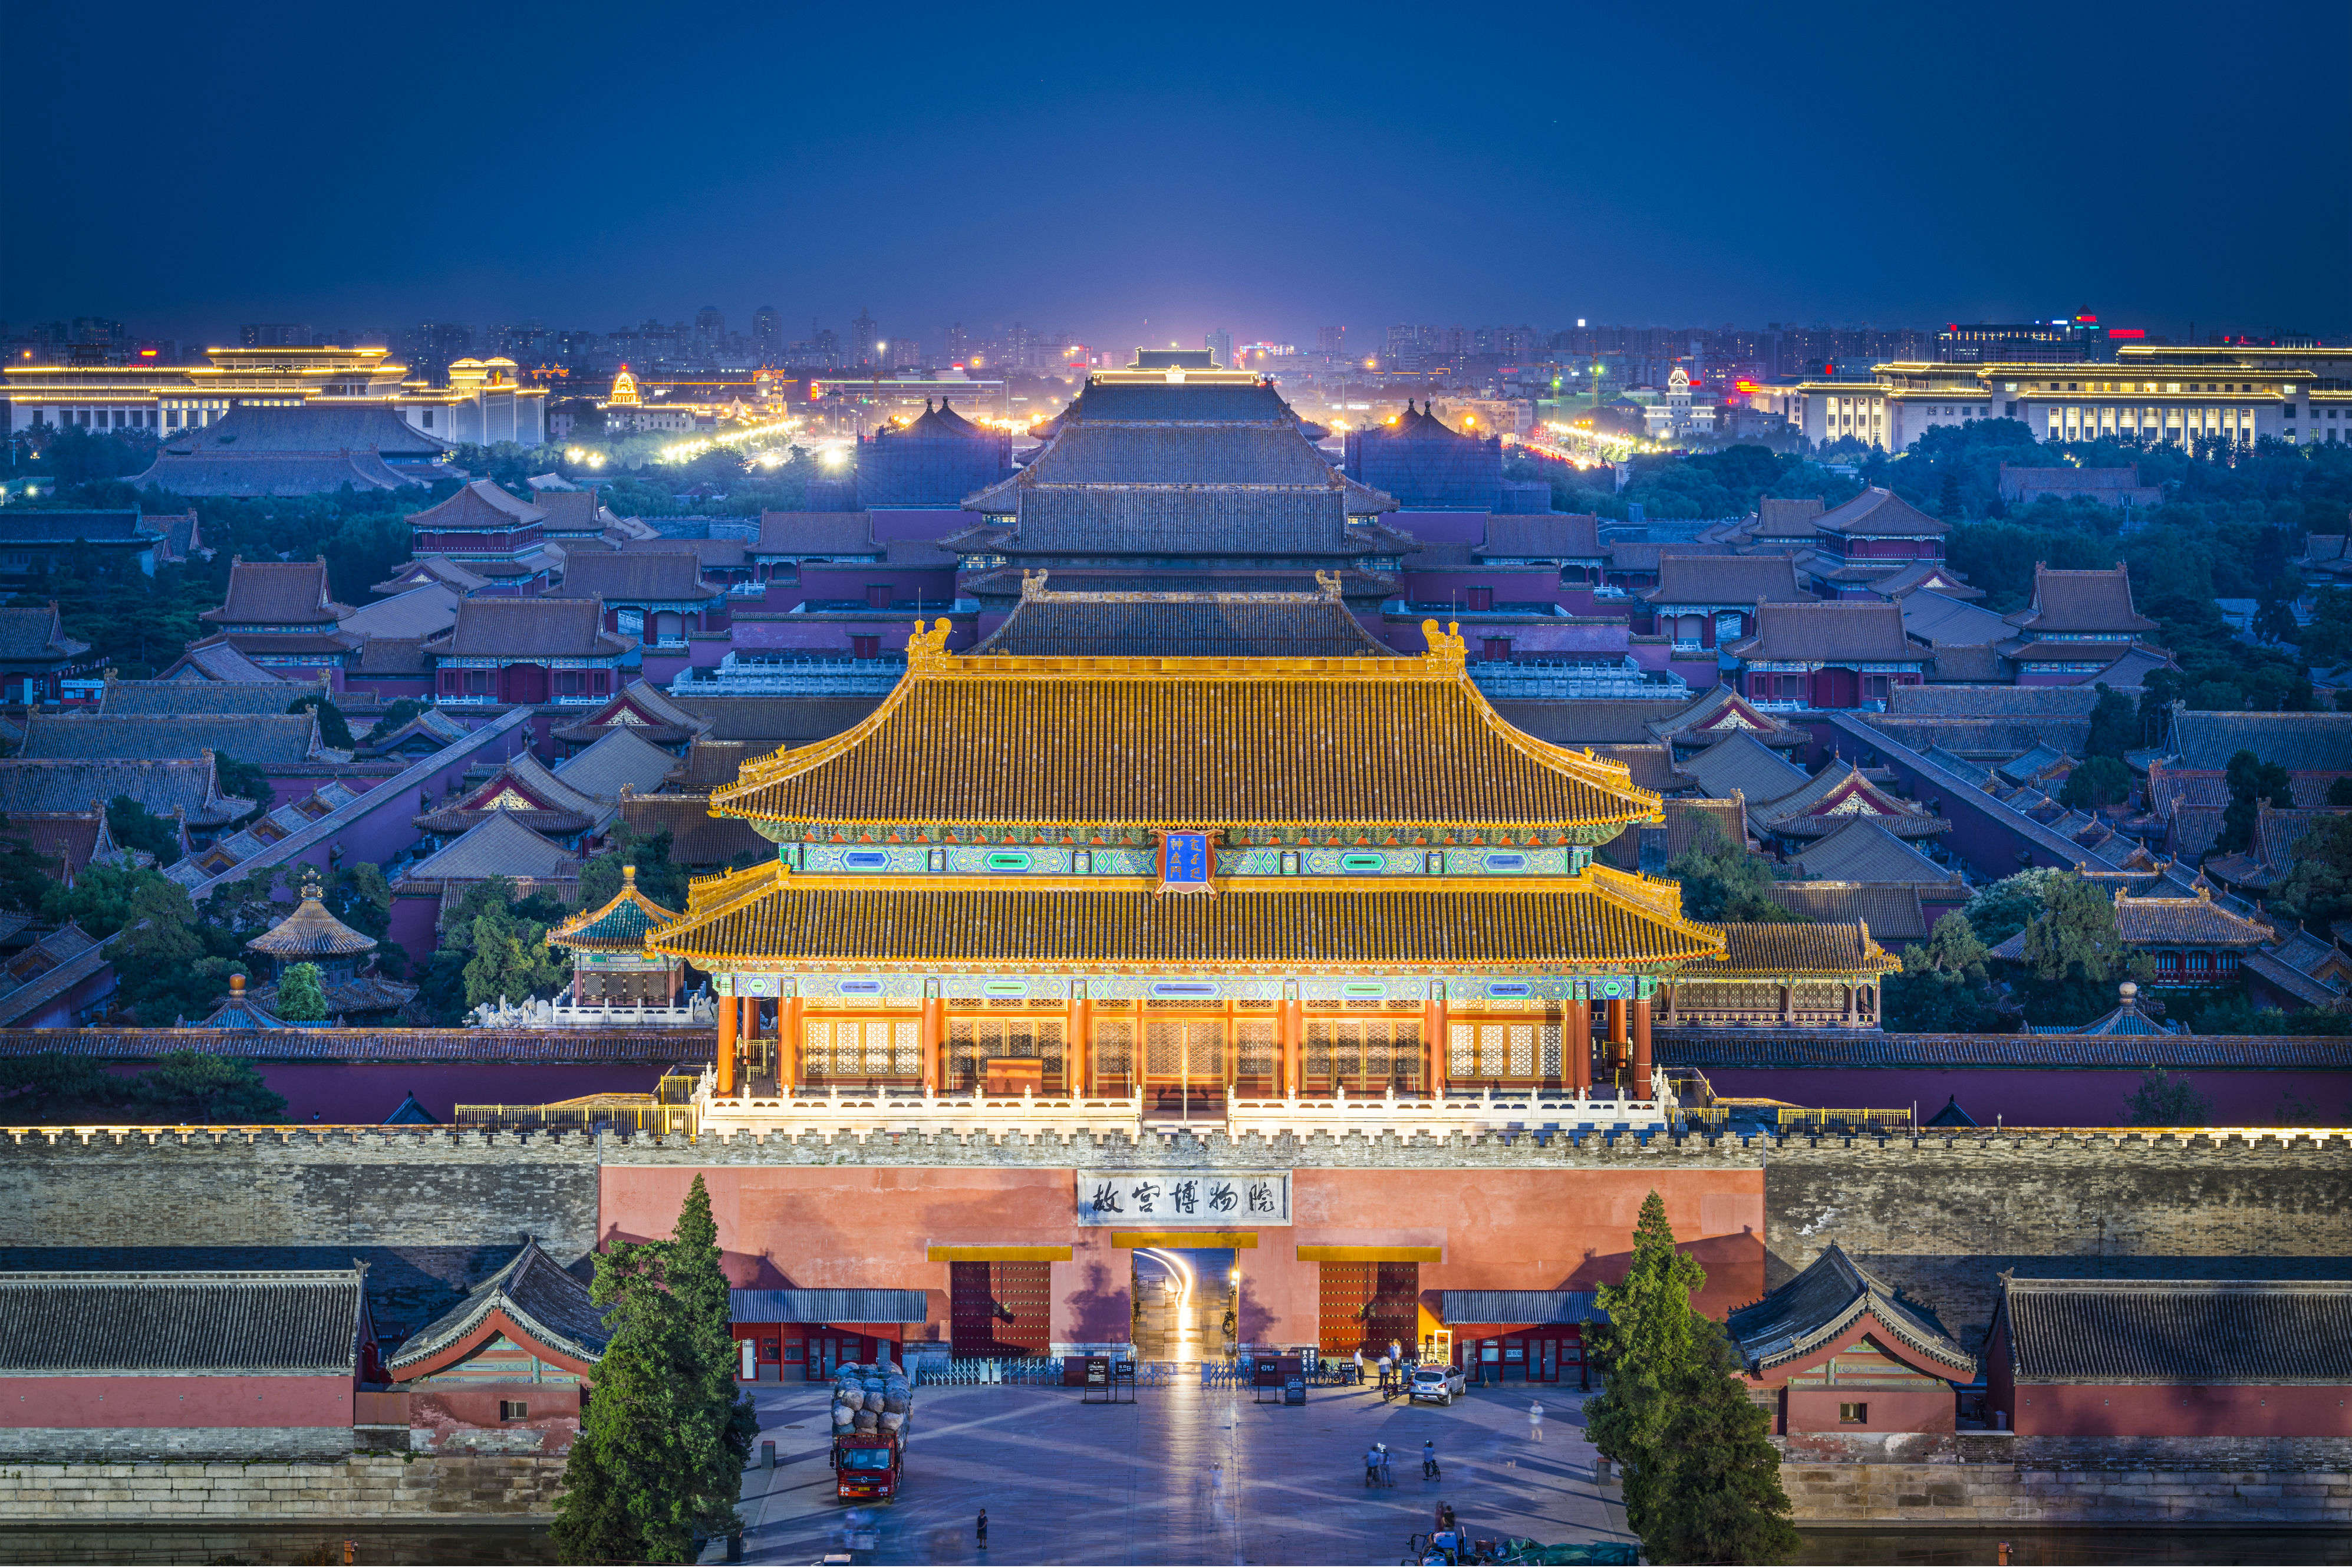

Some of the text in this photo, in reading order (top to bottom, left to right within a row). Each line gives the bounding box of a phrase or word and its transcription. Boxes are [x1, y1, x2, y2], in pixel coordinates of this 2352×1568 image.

[1092, 1181, 1274, 1214] 故宫博物院
